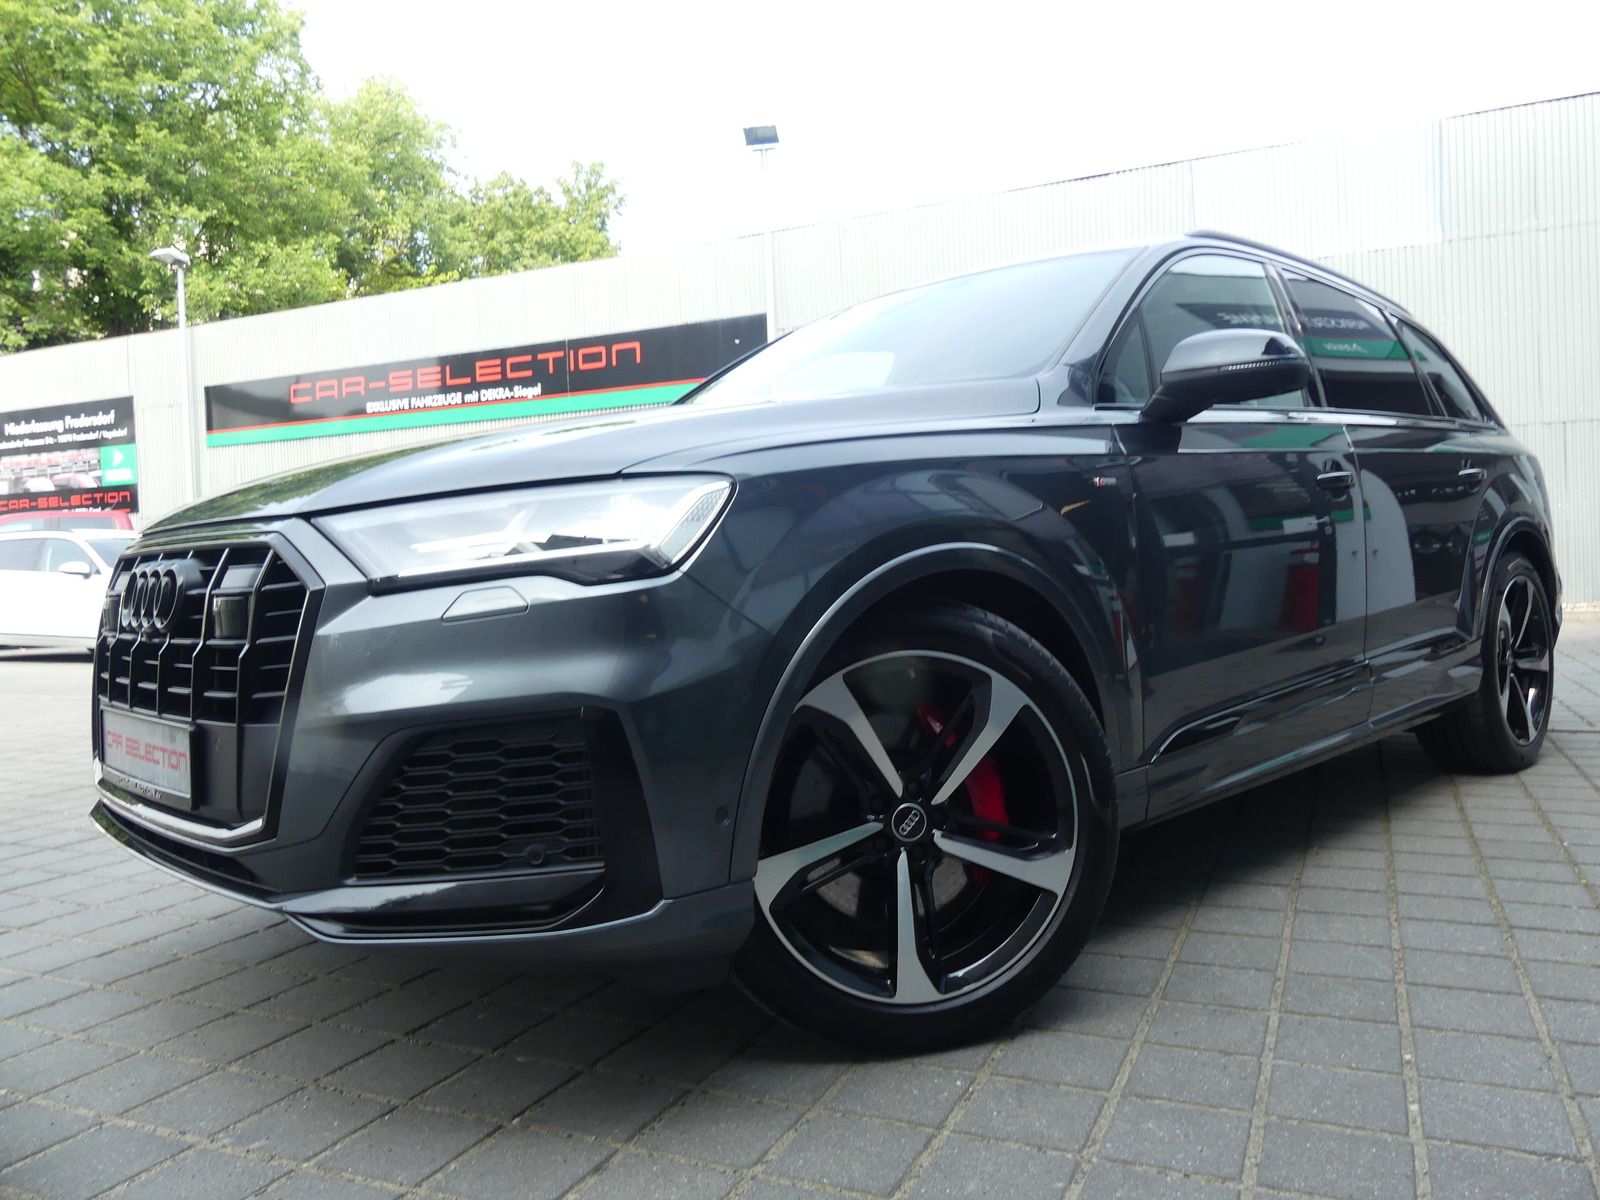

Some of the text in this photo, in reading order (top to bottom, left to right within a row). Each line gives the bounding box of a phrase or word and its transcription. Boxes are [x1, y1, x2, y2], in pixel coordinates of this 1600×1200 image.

[289, 340, 641, 405] CAR-SELECTION
[366, 382, 542, 413] EXKLUSIVE FAHRZEUGE mit DEKRA-Siegel
[65, 409, 115, 430] Fredersdorf
[0, 491, 131, 511] CAR-SELECTION
[106, 730, 188, 773] CAR SELECTION
